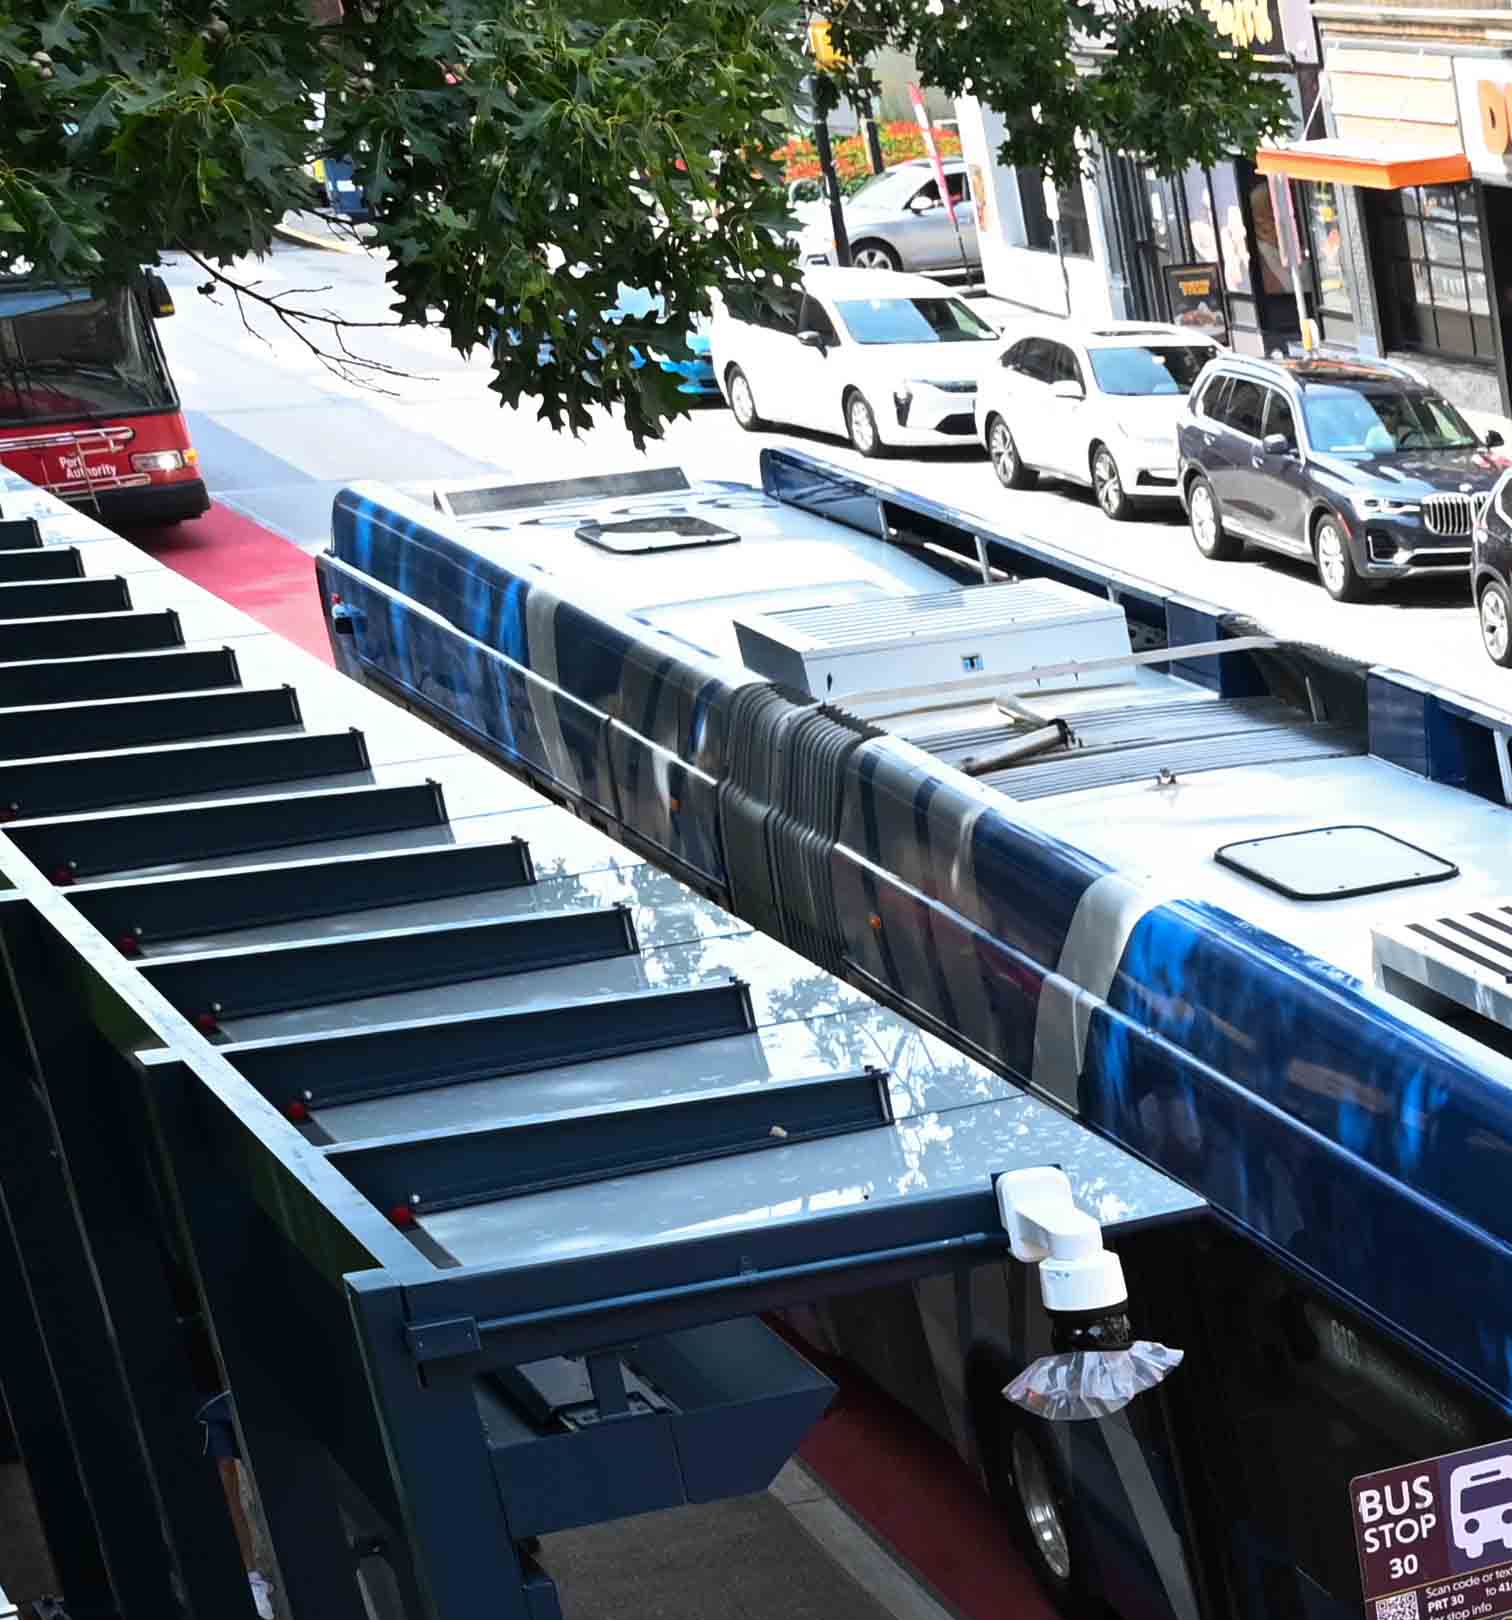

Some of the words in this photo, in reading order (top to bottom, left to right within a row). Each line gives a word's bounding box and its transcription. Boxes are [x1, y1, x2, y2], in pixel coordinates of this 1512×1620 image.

[1358, 1475, 1434, 1524] BUS
[1363, 1513, 1437, 1553] STOP
[1389, 1554, 1419, 1579] 30
[1425, 1584, 1451, 1599] Scan
[1452, 1576, 1480, 1591] code
[1427, 1597, 1449, 1614] PRT
[1450, 1593, 1465, 1607] 30
[1471, 1602, 1493, 1616] info
